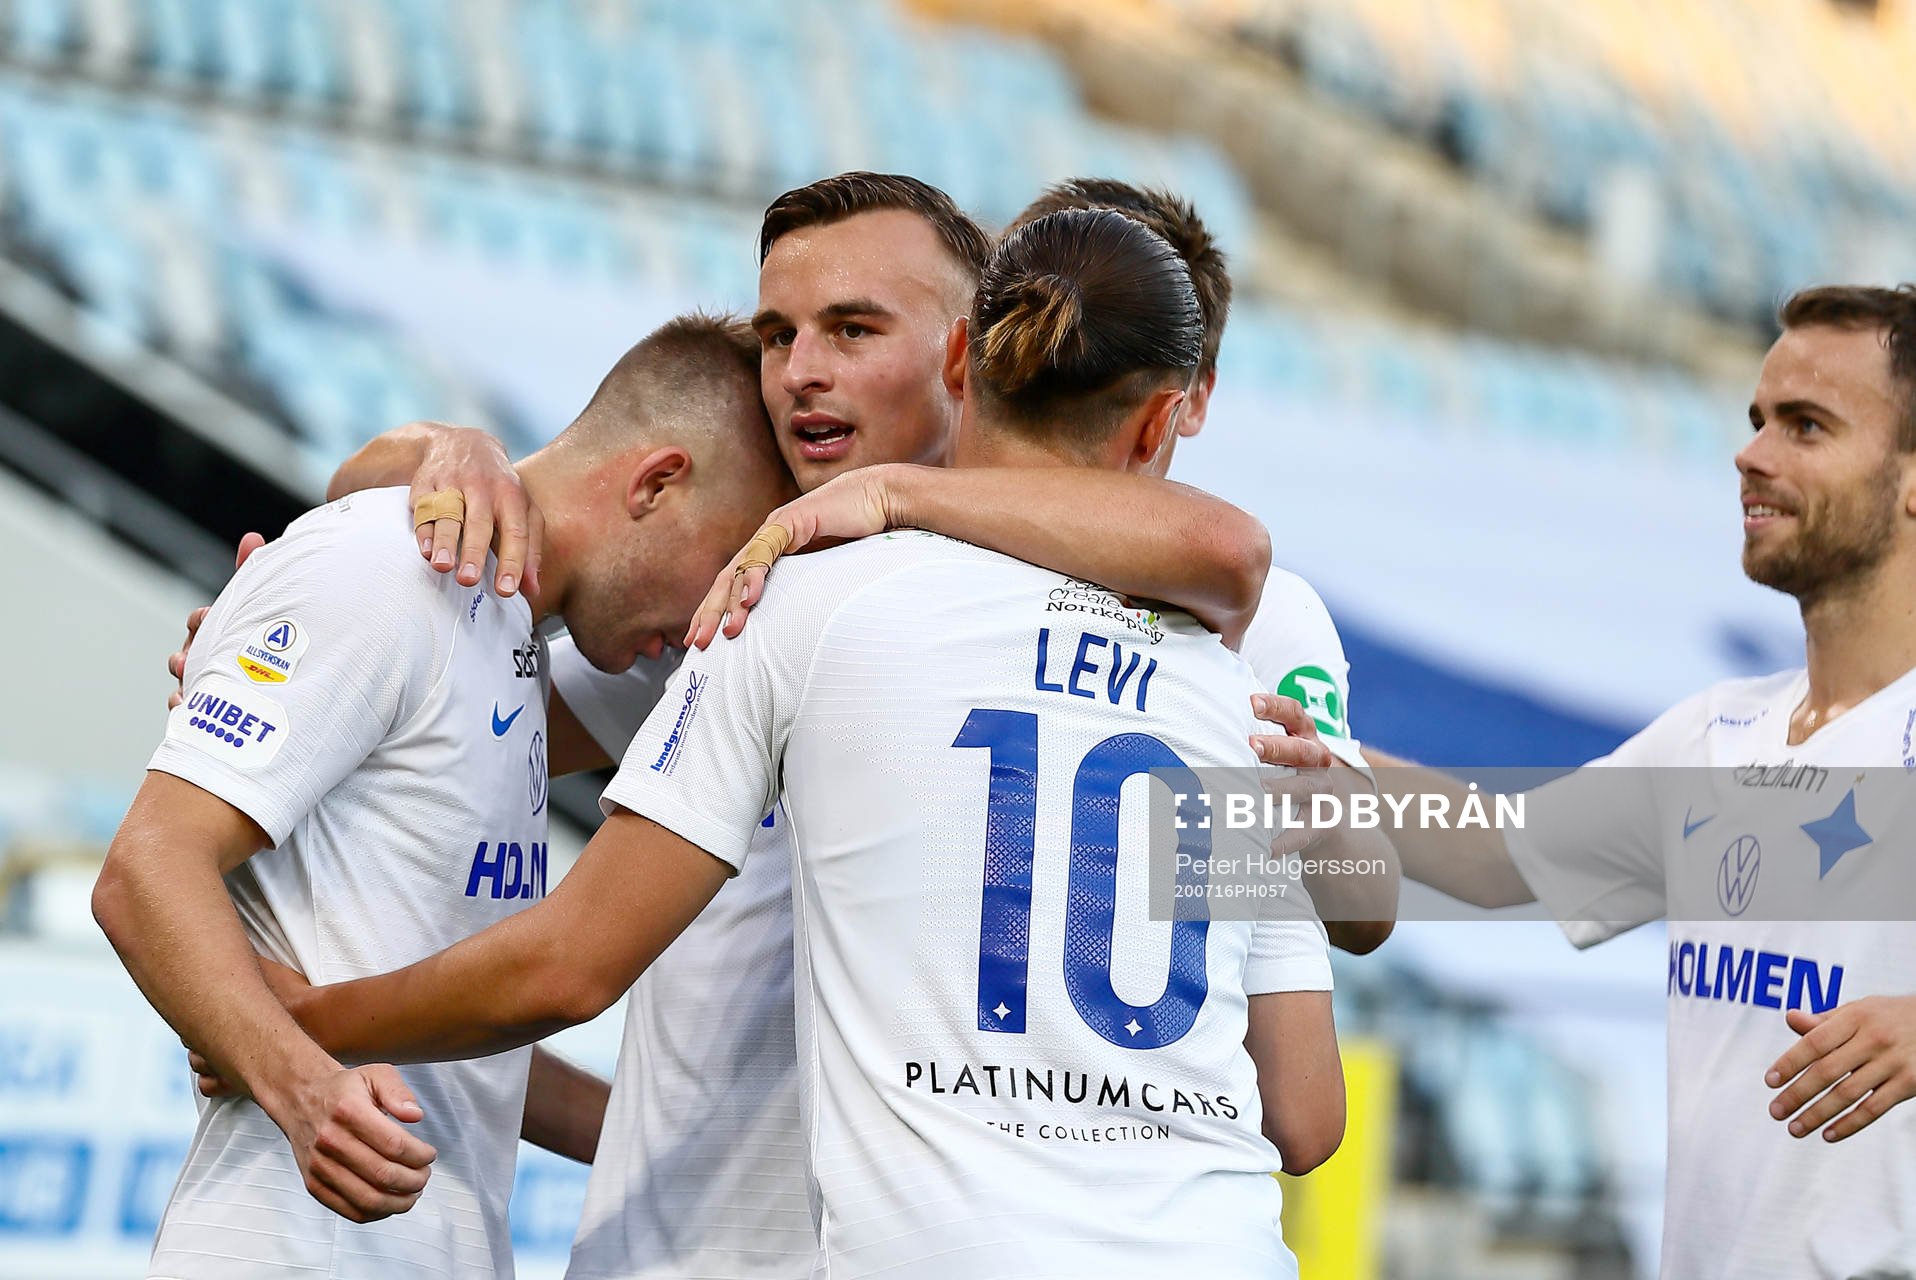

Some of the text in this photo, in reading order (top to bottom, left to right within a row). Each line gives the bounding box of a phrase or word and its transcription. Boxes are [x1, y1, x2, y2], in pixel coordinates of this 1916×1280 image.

[1045, 601, 1165, 645] Norrköping
[1048, 588, 1121, 610] Create
[246, 644, 291, 671] ALLSVENSKAN
[1035, 627, 1158, 712] LEVI
[187, 691, 277, 743] UNIBET
[951, 708, 1213, 1050] 10
[1667, 939, 1845, 1015] HOLMEN
[905, 1061, 1240, 1121] PLATINUMCARS
[1039, 1123, 1170, 1143] COLLECTION
